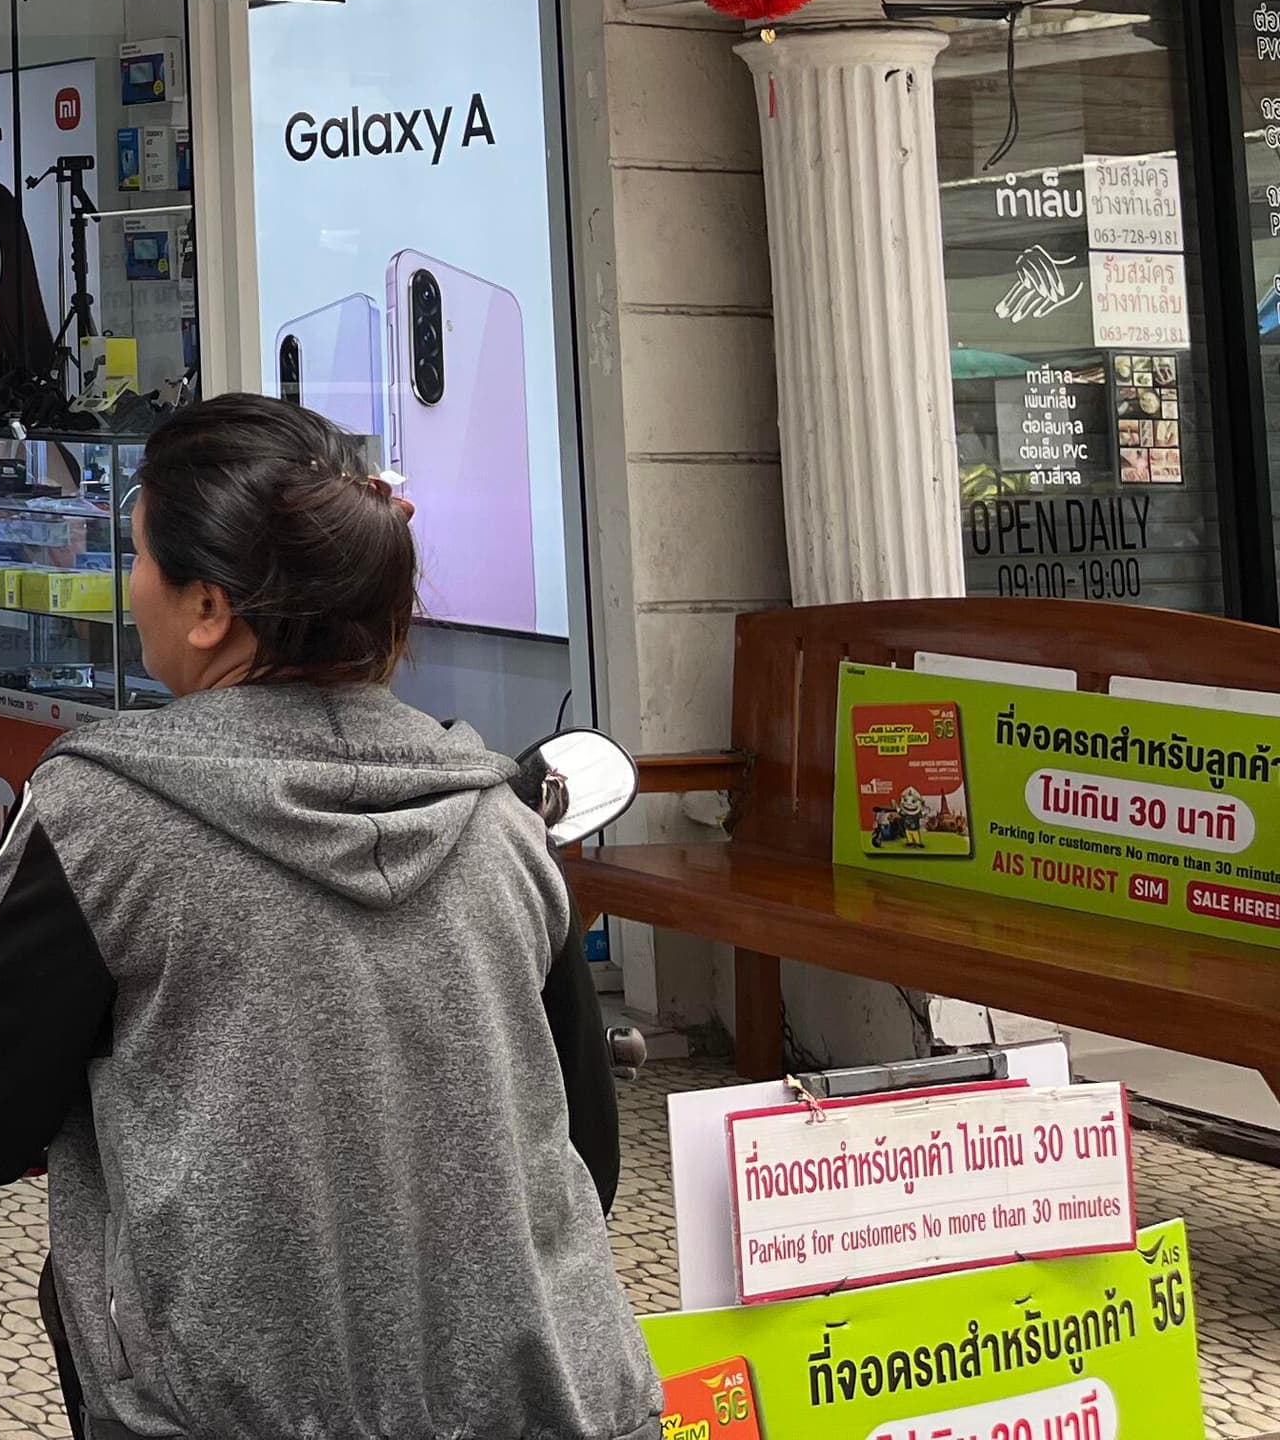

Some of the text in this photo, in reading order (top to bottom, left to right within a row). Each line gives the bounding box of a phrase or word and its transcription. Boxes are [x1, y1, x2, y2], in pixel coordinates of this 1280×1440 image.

[284, 92, 496, 165] Galaxy A
[996, 168, 1084, 219] ทำเล็บ
[1095, 158, 1170, 189] รับสมัคร
[1091, 185, 1177, 219] ช่างทำเล็บ
[1093, 227, 1179, 246] 063-728-9181
[1102, 256, 1176, 289] รับสมัคร
[1097, 284, 1182, 317] ช่างทำเล็บ
[1099, 325, 1185, 344] 063-728-9181
[1063, 443, 1089, 461] PVC
[970, 495, 1151, 556] OPEN DAILY
[856, 734, 928, 745] TOURIST SIM
[1039, 773, 1237, 842] ไม่เกิน 30 นาที
[989, 821, 1035, 845] Parking
[1038, 830, 1056, 846] for
[1058, 836, 1122, 857] customers
[1125, 845, 1143, 861] No
[1146, 852, 1180, 867] more
[1183, 855, 1211, 873] than
[1215, 860, 1232, 875] 30
[991, 848, 1025, 877] AIS
[1032, 857, 1119, 894] TOURIST
[1134, 878, 1163, 900] SIM
[1192, 889, 1229, 911] SALE
[744, 1110, 1118, 1203] ที่จอดรถสำหรับลูกค้า ไม่เกิน 30 นาที
[748, 1194, 1121, 1267] Parking for customers No more than 30 minutes
[1159, 1245, 1181, 1267] AIS
[1150, 1269, 1187, 1334] 5G
[808, 1286, 1137, 1408] ที่จอดรถสำหรับลูกค้า
[723, 1373, 745, 1389] AIS
[712, 1386, 749, 1427] 5G
